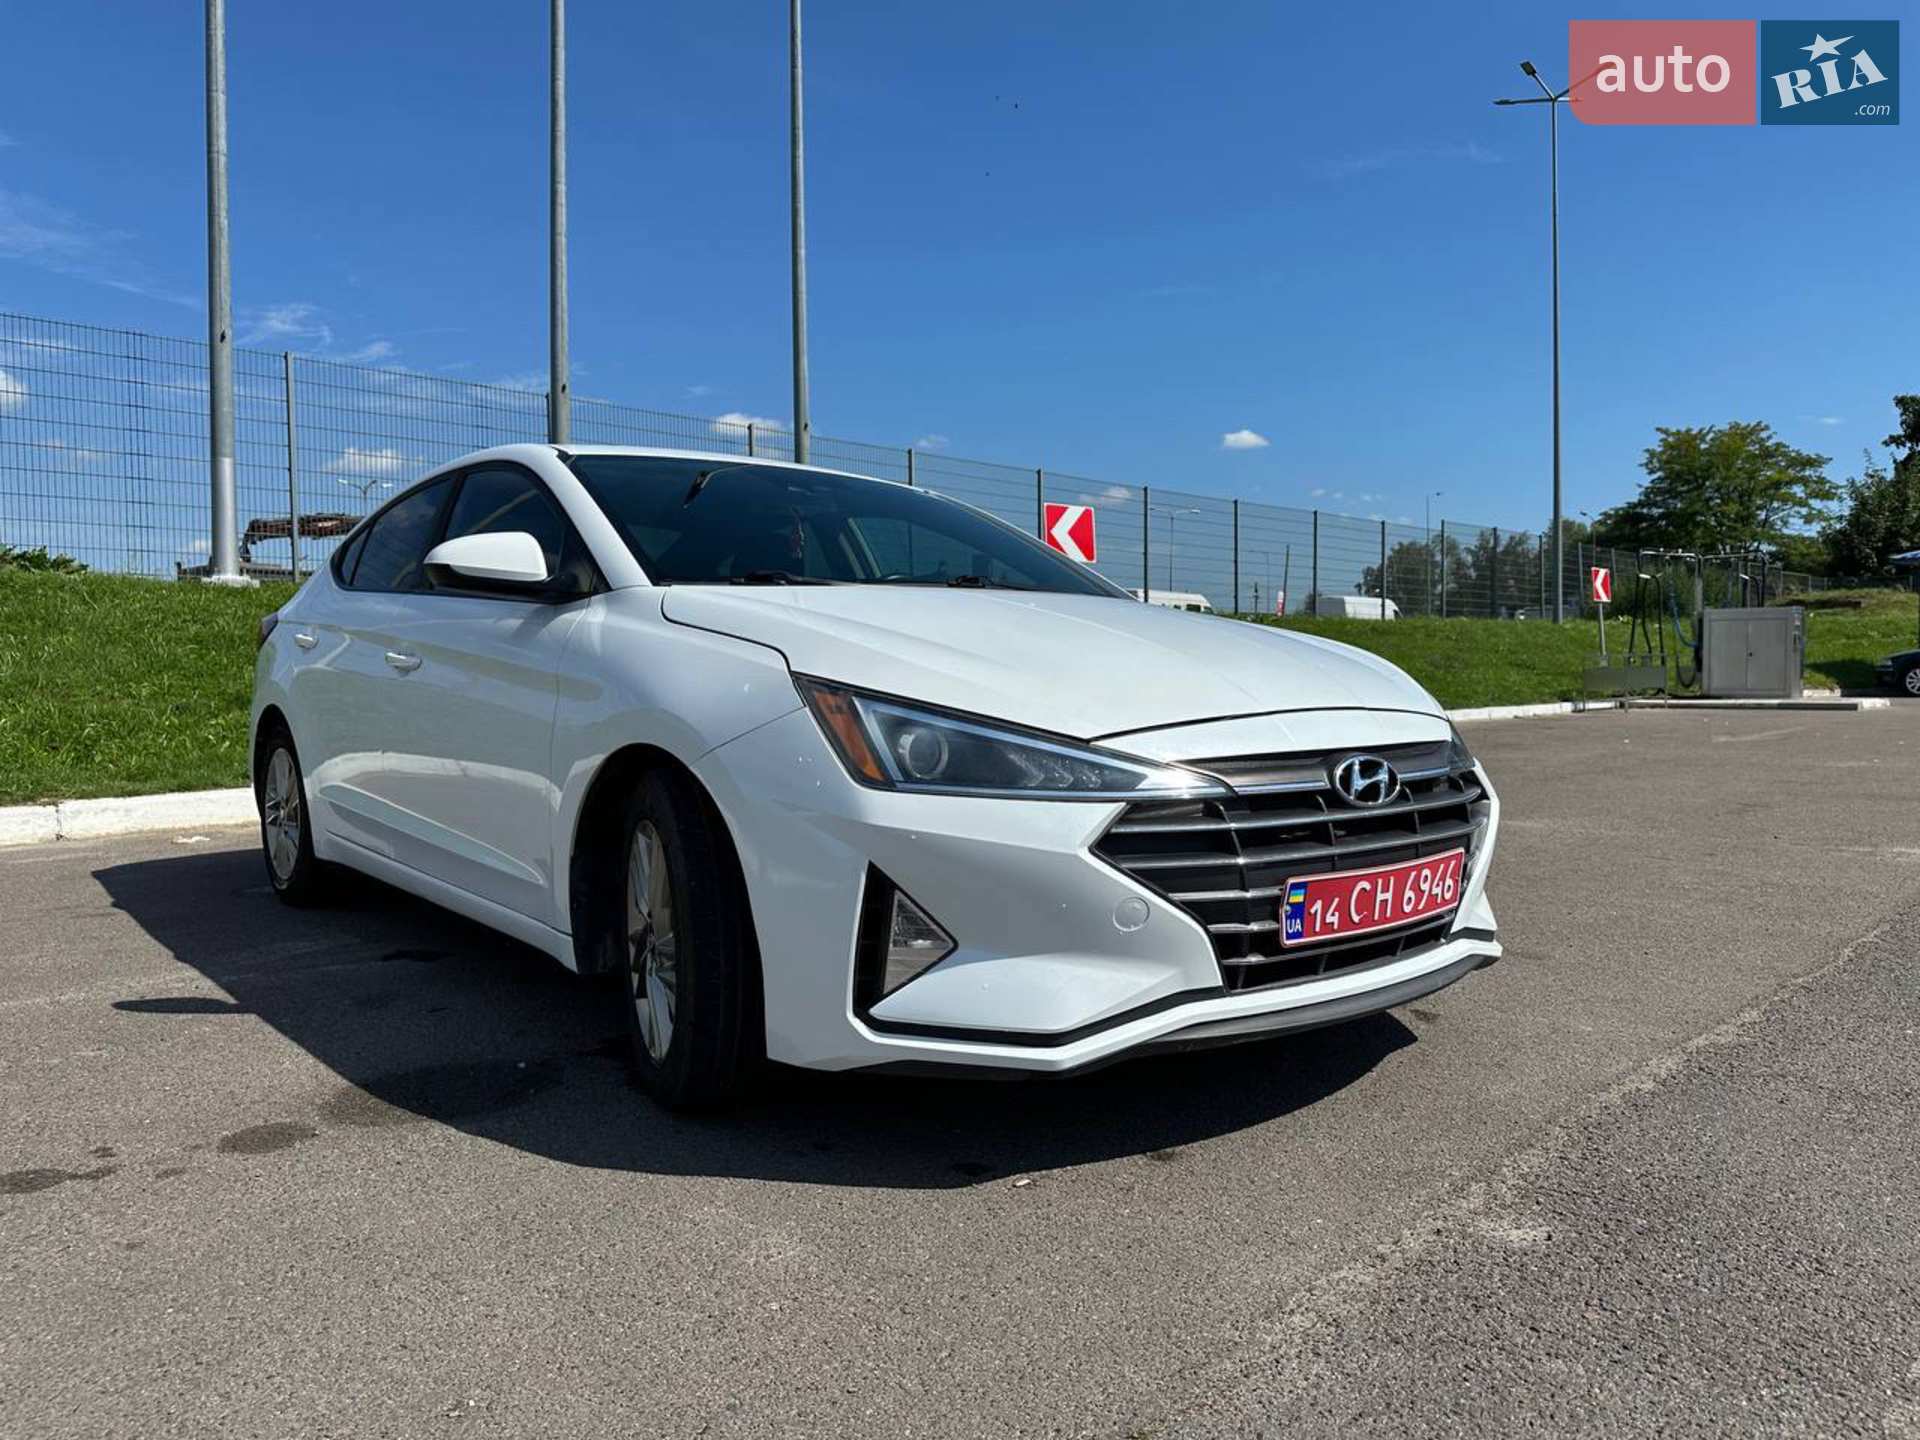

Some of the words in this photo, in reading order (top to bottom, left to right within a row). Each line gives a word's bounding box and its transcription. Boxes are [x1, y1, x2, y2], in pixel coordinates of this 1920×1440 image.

[1309, 897, 1340, 933] 14
[1349, 876, 1395, 924] CH
[1402, 860, 1456, 913] 6946
[1286, 918, 1302, 934] UA
